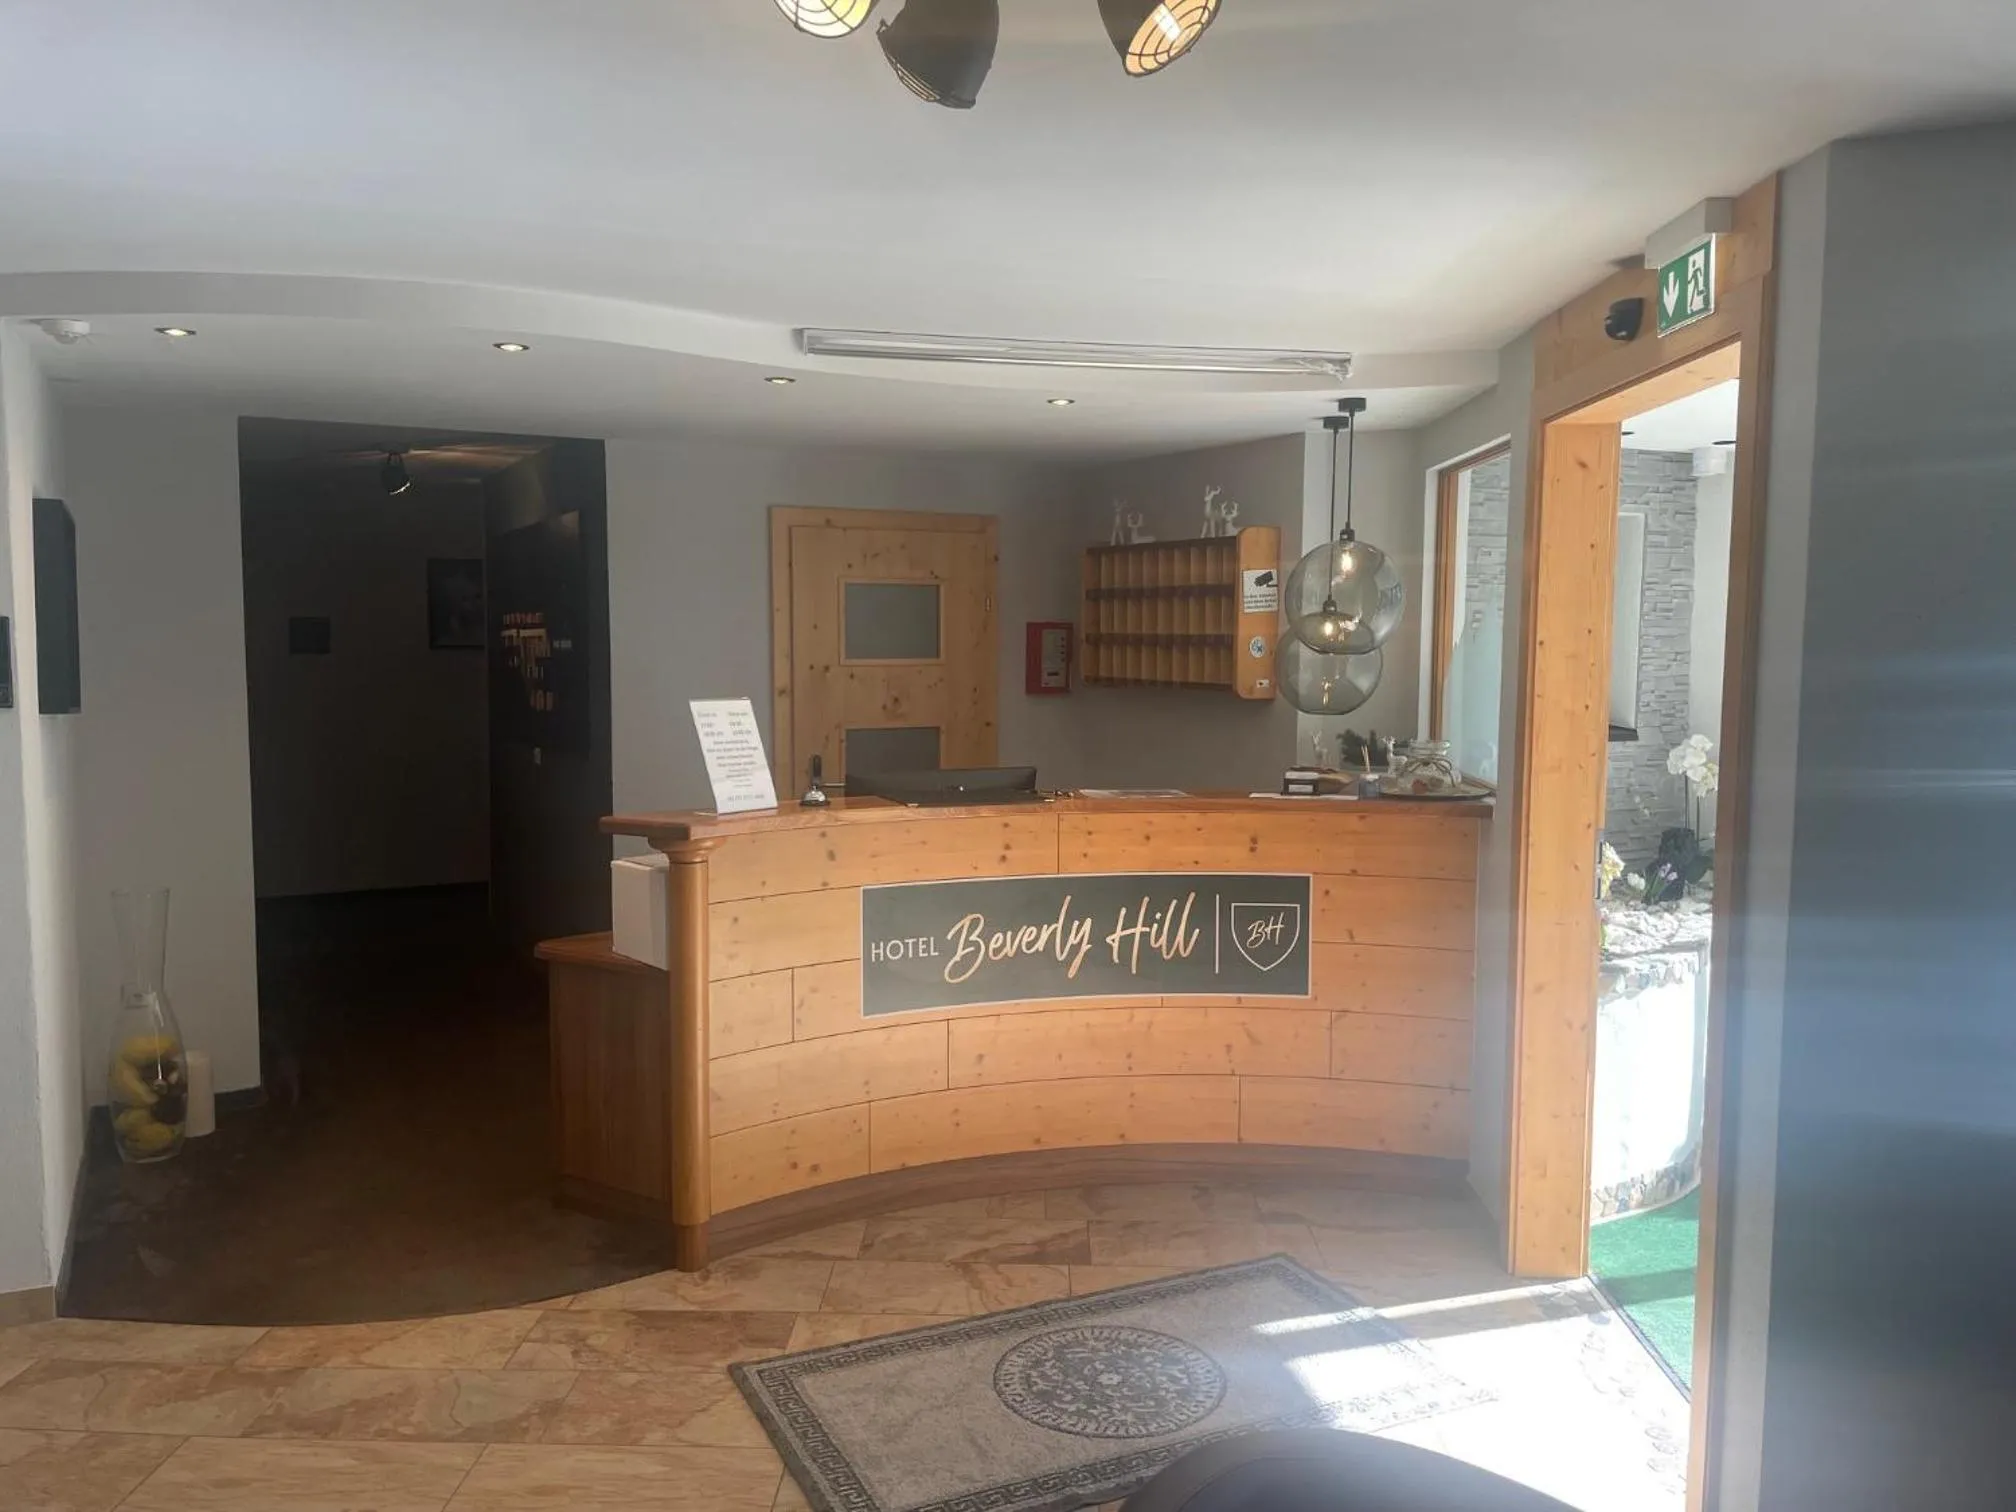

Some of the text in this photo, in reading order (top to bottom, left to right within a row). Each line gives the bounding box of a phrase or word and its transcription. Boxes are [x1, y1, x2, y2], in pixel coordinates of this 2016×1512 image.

[871, 892, 1200, 984] HOTEL Beverly Hill
[1246, 912, 1285, 949] BH
